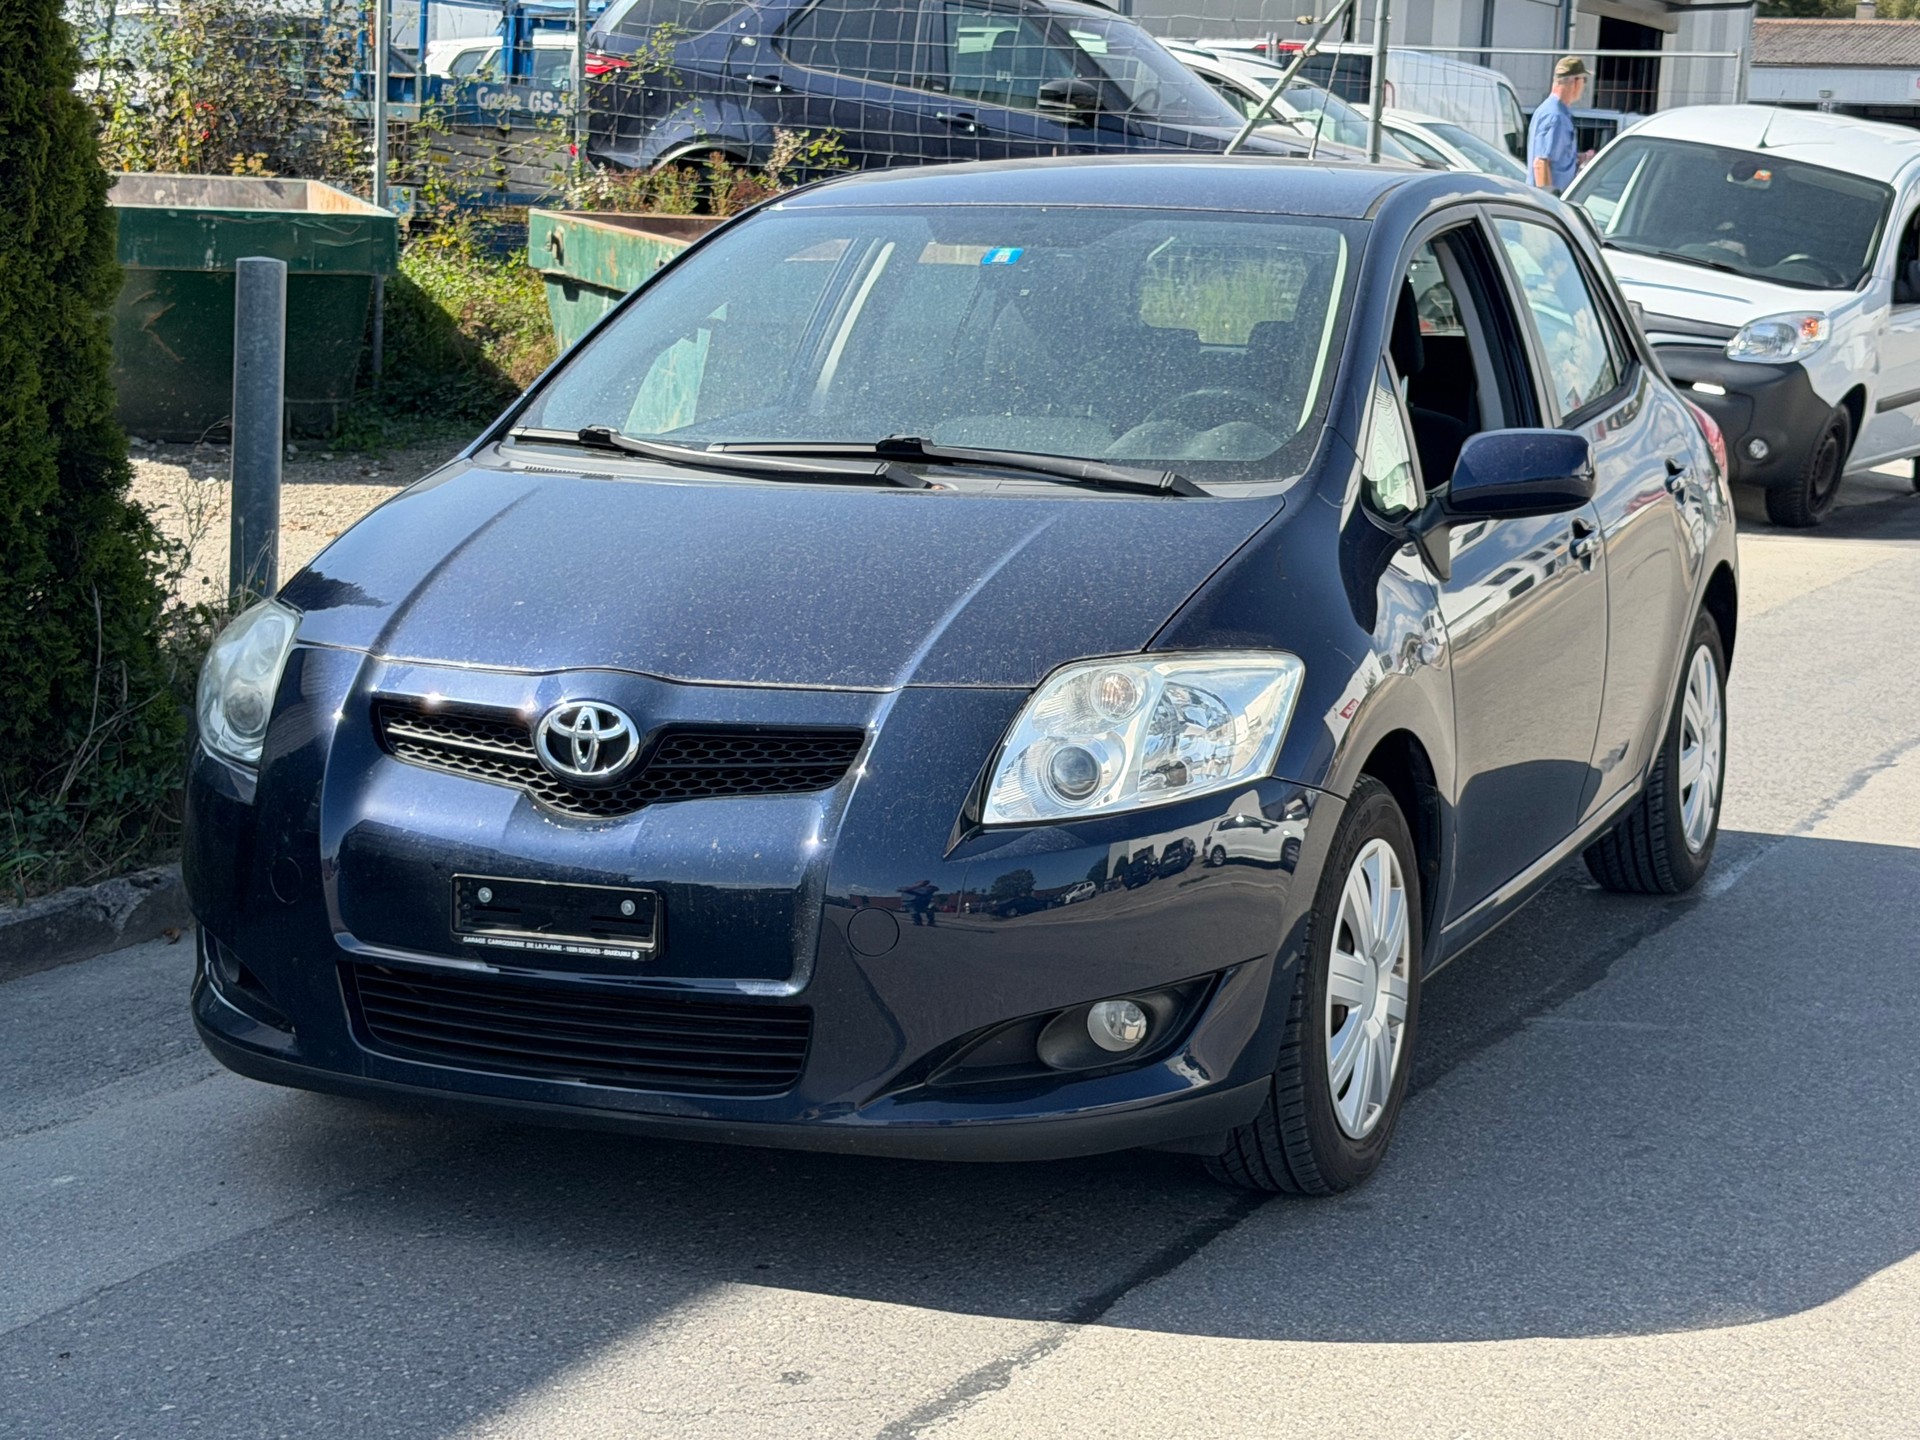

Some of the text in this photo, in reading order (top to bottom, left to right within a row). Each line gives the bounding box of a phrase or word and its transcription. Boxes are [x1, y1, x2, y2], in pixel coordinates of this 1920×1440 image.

[463, 936, 486, 945] GARAGE
[487, 938, 525, 948] CARROSSERIE
[535, 942, 543, 950] LA
[604, 949, 631, 957] SUZUKI
